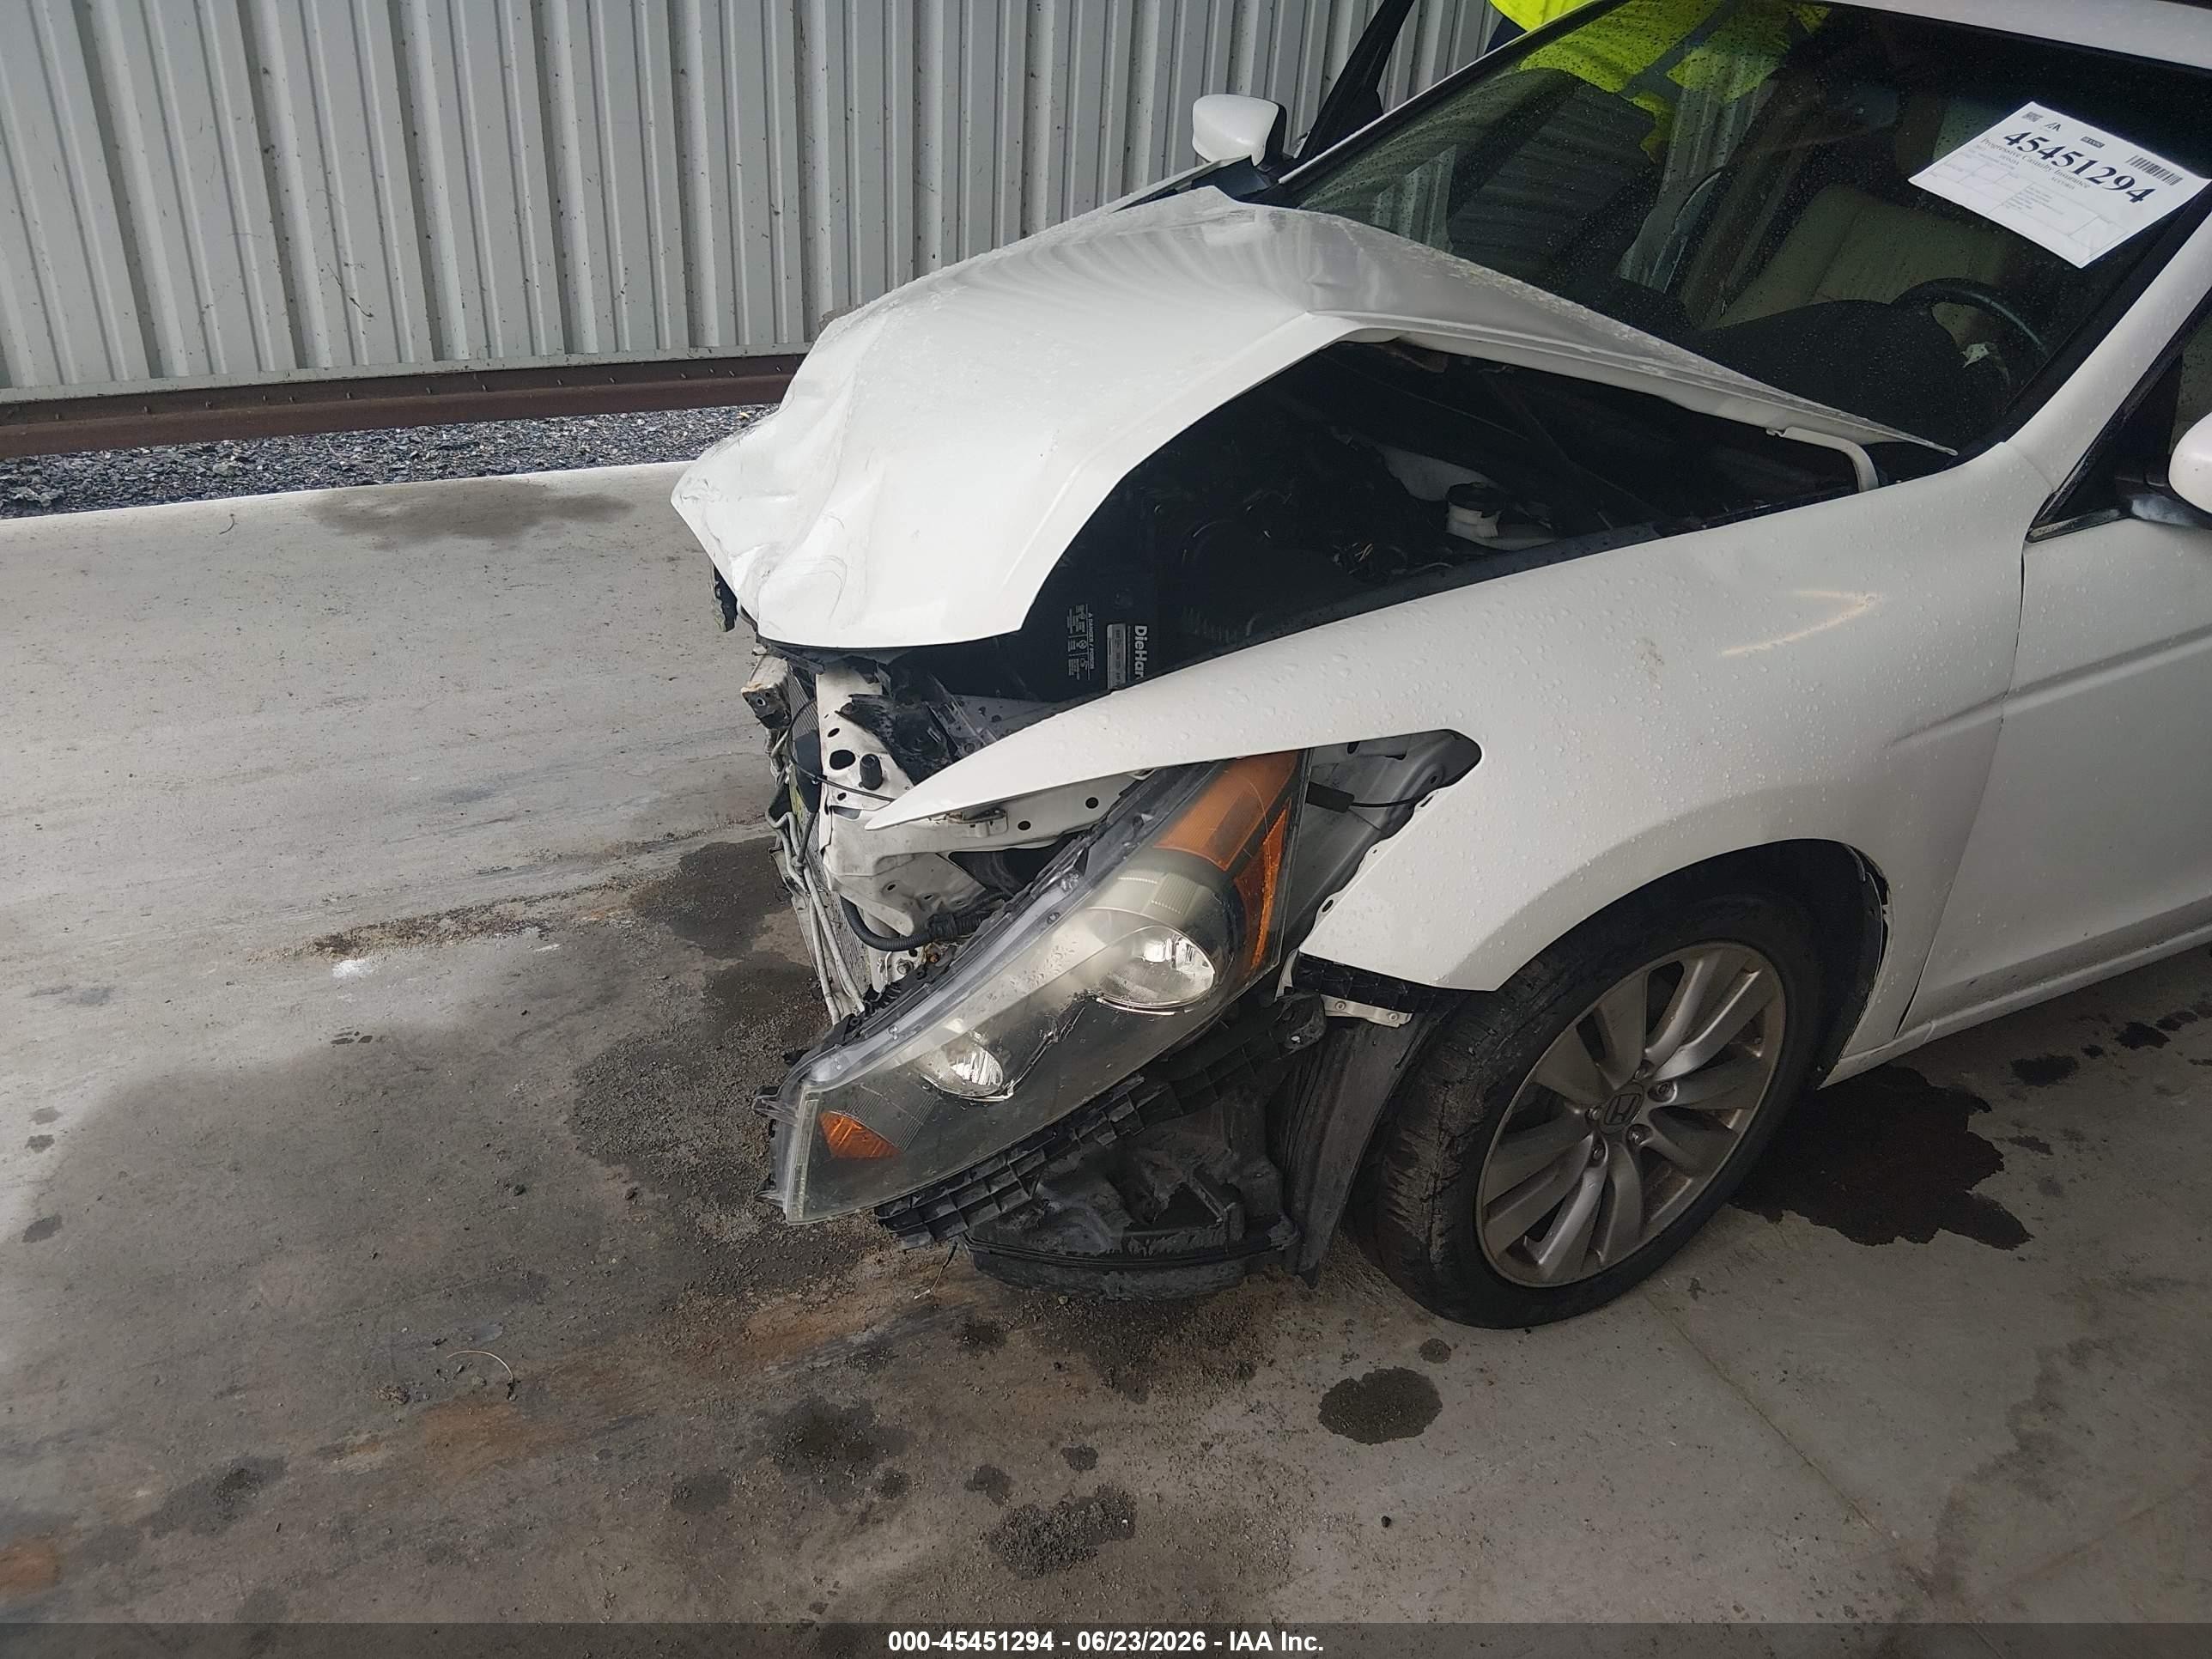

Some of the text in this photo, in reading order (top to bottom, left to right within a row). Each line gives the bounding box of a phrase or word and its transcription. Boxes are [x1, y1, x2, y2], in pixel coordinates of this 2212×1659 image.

[1981, 137, 2022, 158] Progressive
[2022, 155, 2056, 172] Casualty
[2054, 169, 2091, 188] Insurance
[2003, 131, 2156, 204] 45451294
[1134, 625, 1148, 678] DieHar
